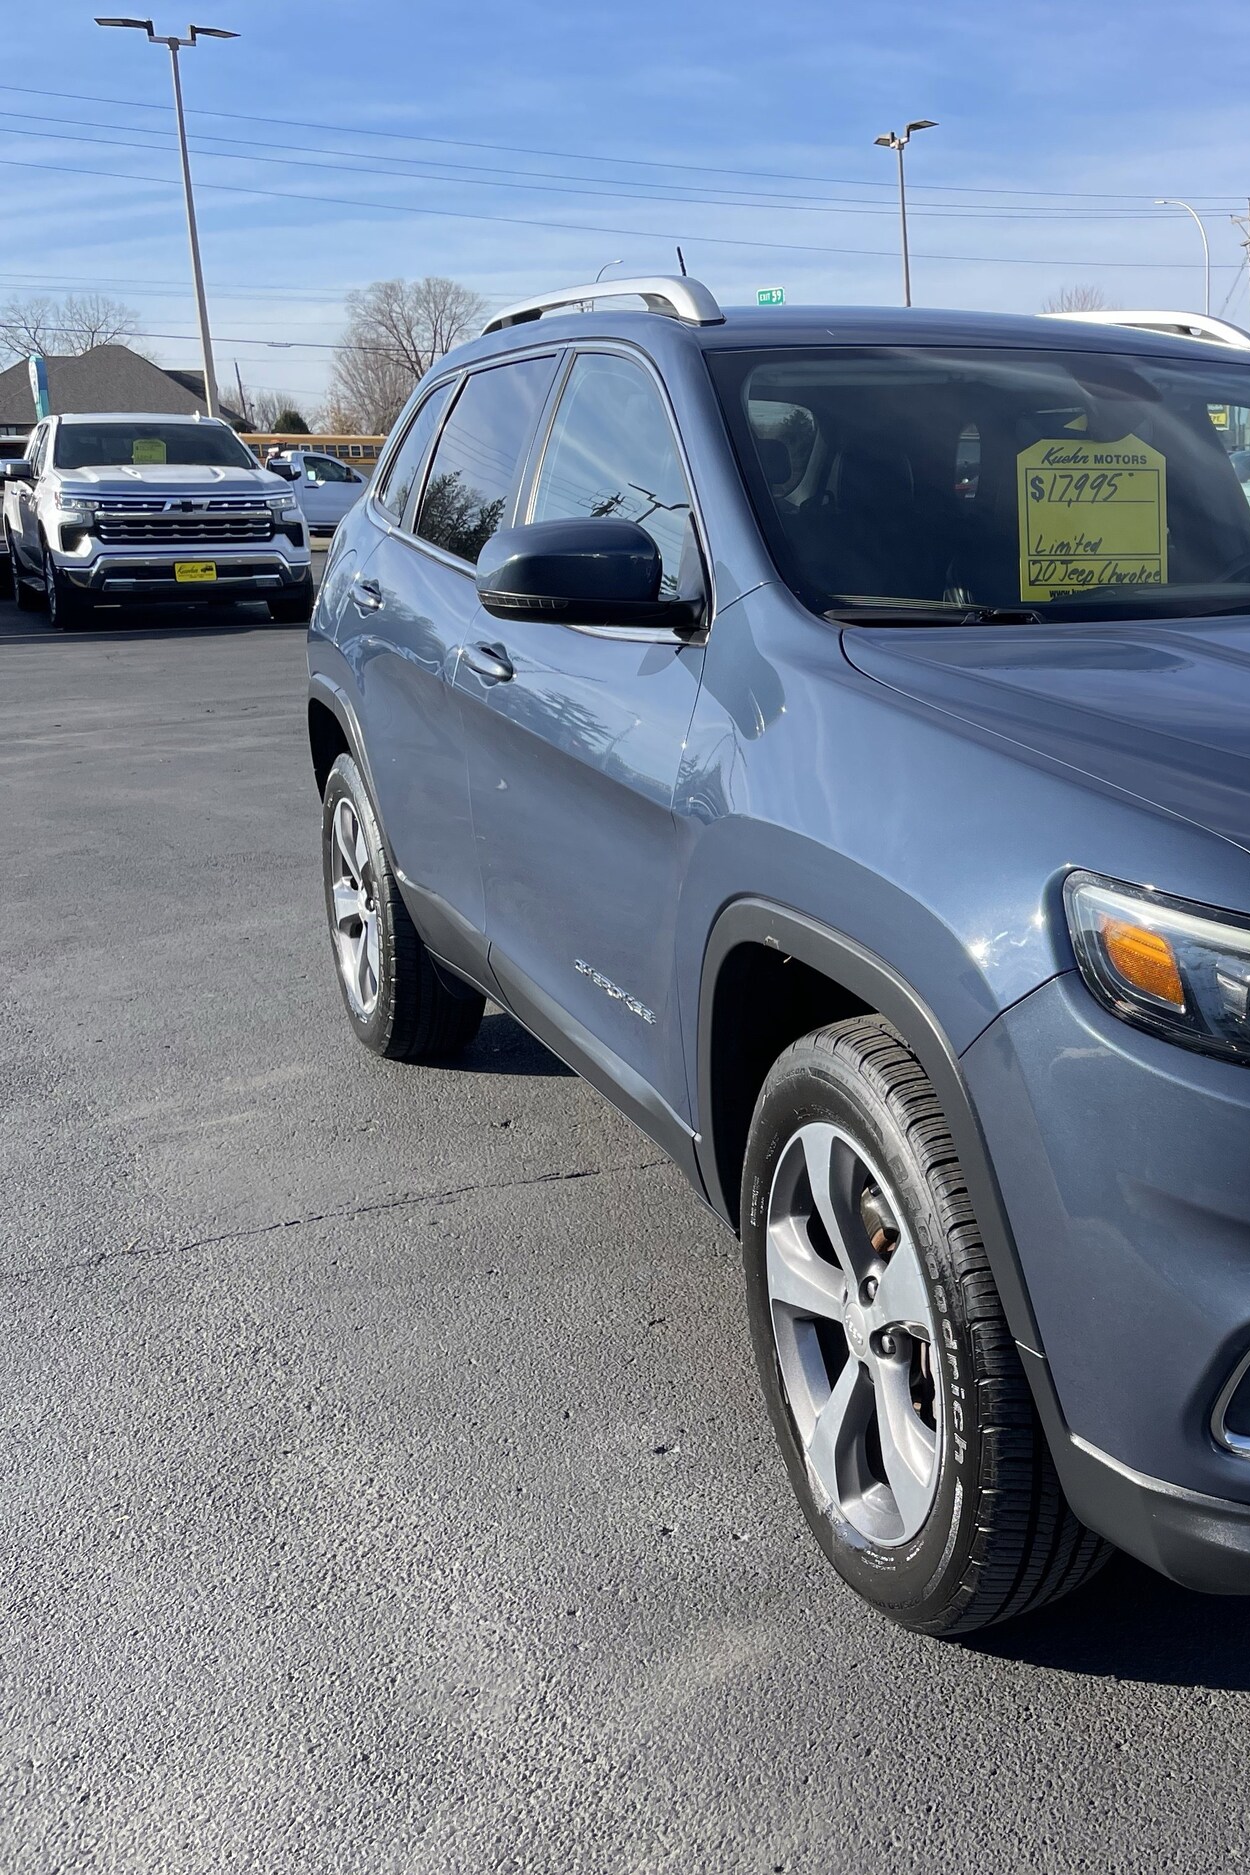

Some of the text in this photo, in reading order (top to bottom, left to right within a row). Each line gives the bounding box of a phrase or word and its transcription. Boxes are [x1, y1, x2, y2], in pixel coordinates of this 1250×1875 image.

[771, 290, 782, 303] 59
[1041, 446, 1148, 466] Kuehn MOTORS
[1034, 532, 1103, 555] Limited
[1030, 559, 1162, 586] 20 Jeep Cherokee
